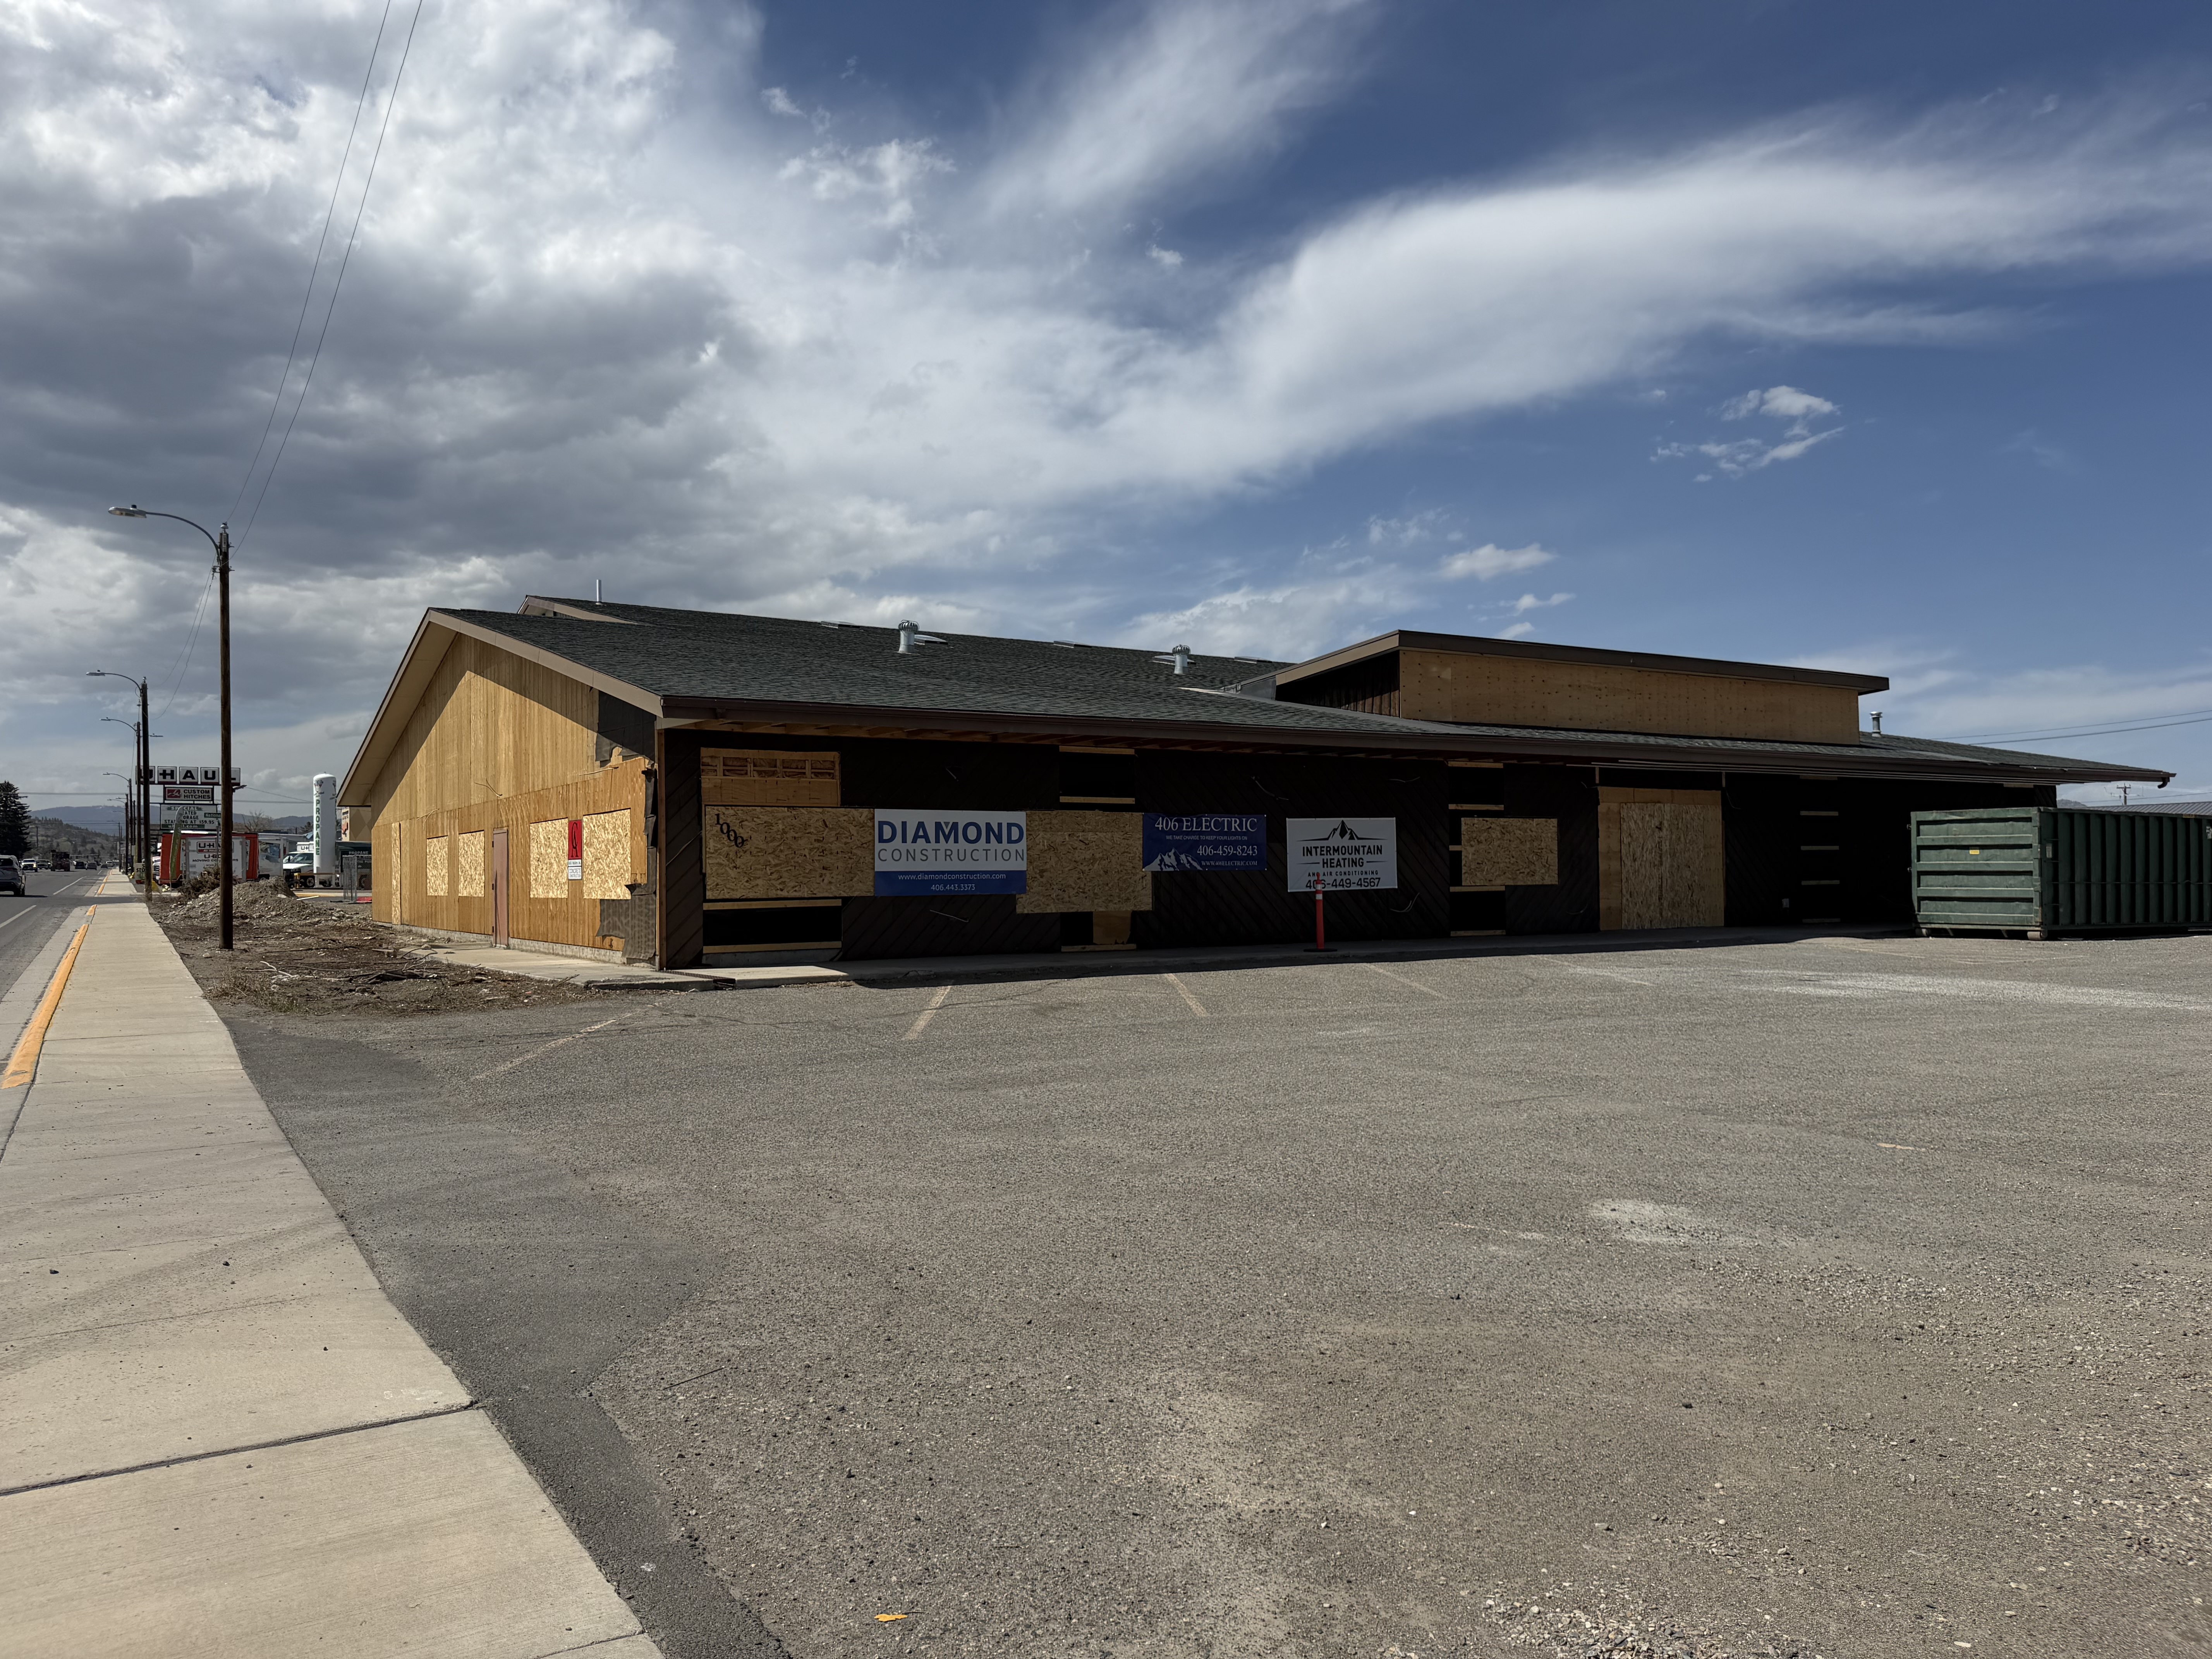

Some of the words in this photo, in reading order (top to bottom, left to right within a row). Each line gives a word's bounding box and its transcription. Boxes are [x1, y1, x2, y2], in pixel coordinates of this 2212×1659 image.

[715, 813, 744, 848] 1000
[1154, 816, 1178, 831] 406
[1182, 817, 1257, 832] ELECTRIC
[878, 820, 1024, 844] DIAMOND
[878, 848, 1024, 862] CONSTRUCTION
[1197, 845, 1258, 856] 406-459-8243
[1302, 845, 1382, 857] INTERMOUNTAIN
[1322, 857, 1364, 868] HEATING
[898, 872, 1006, 881] www.diamondconstruction.com
